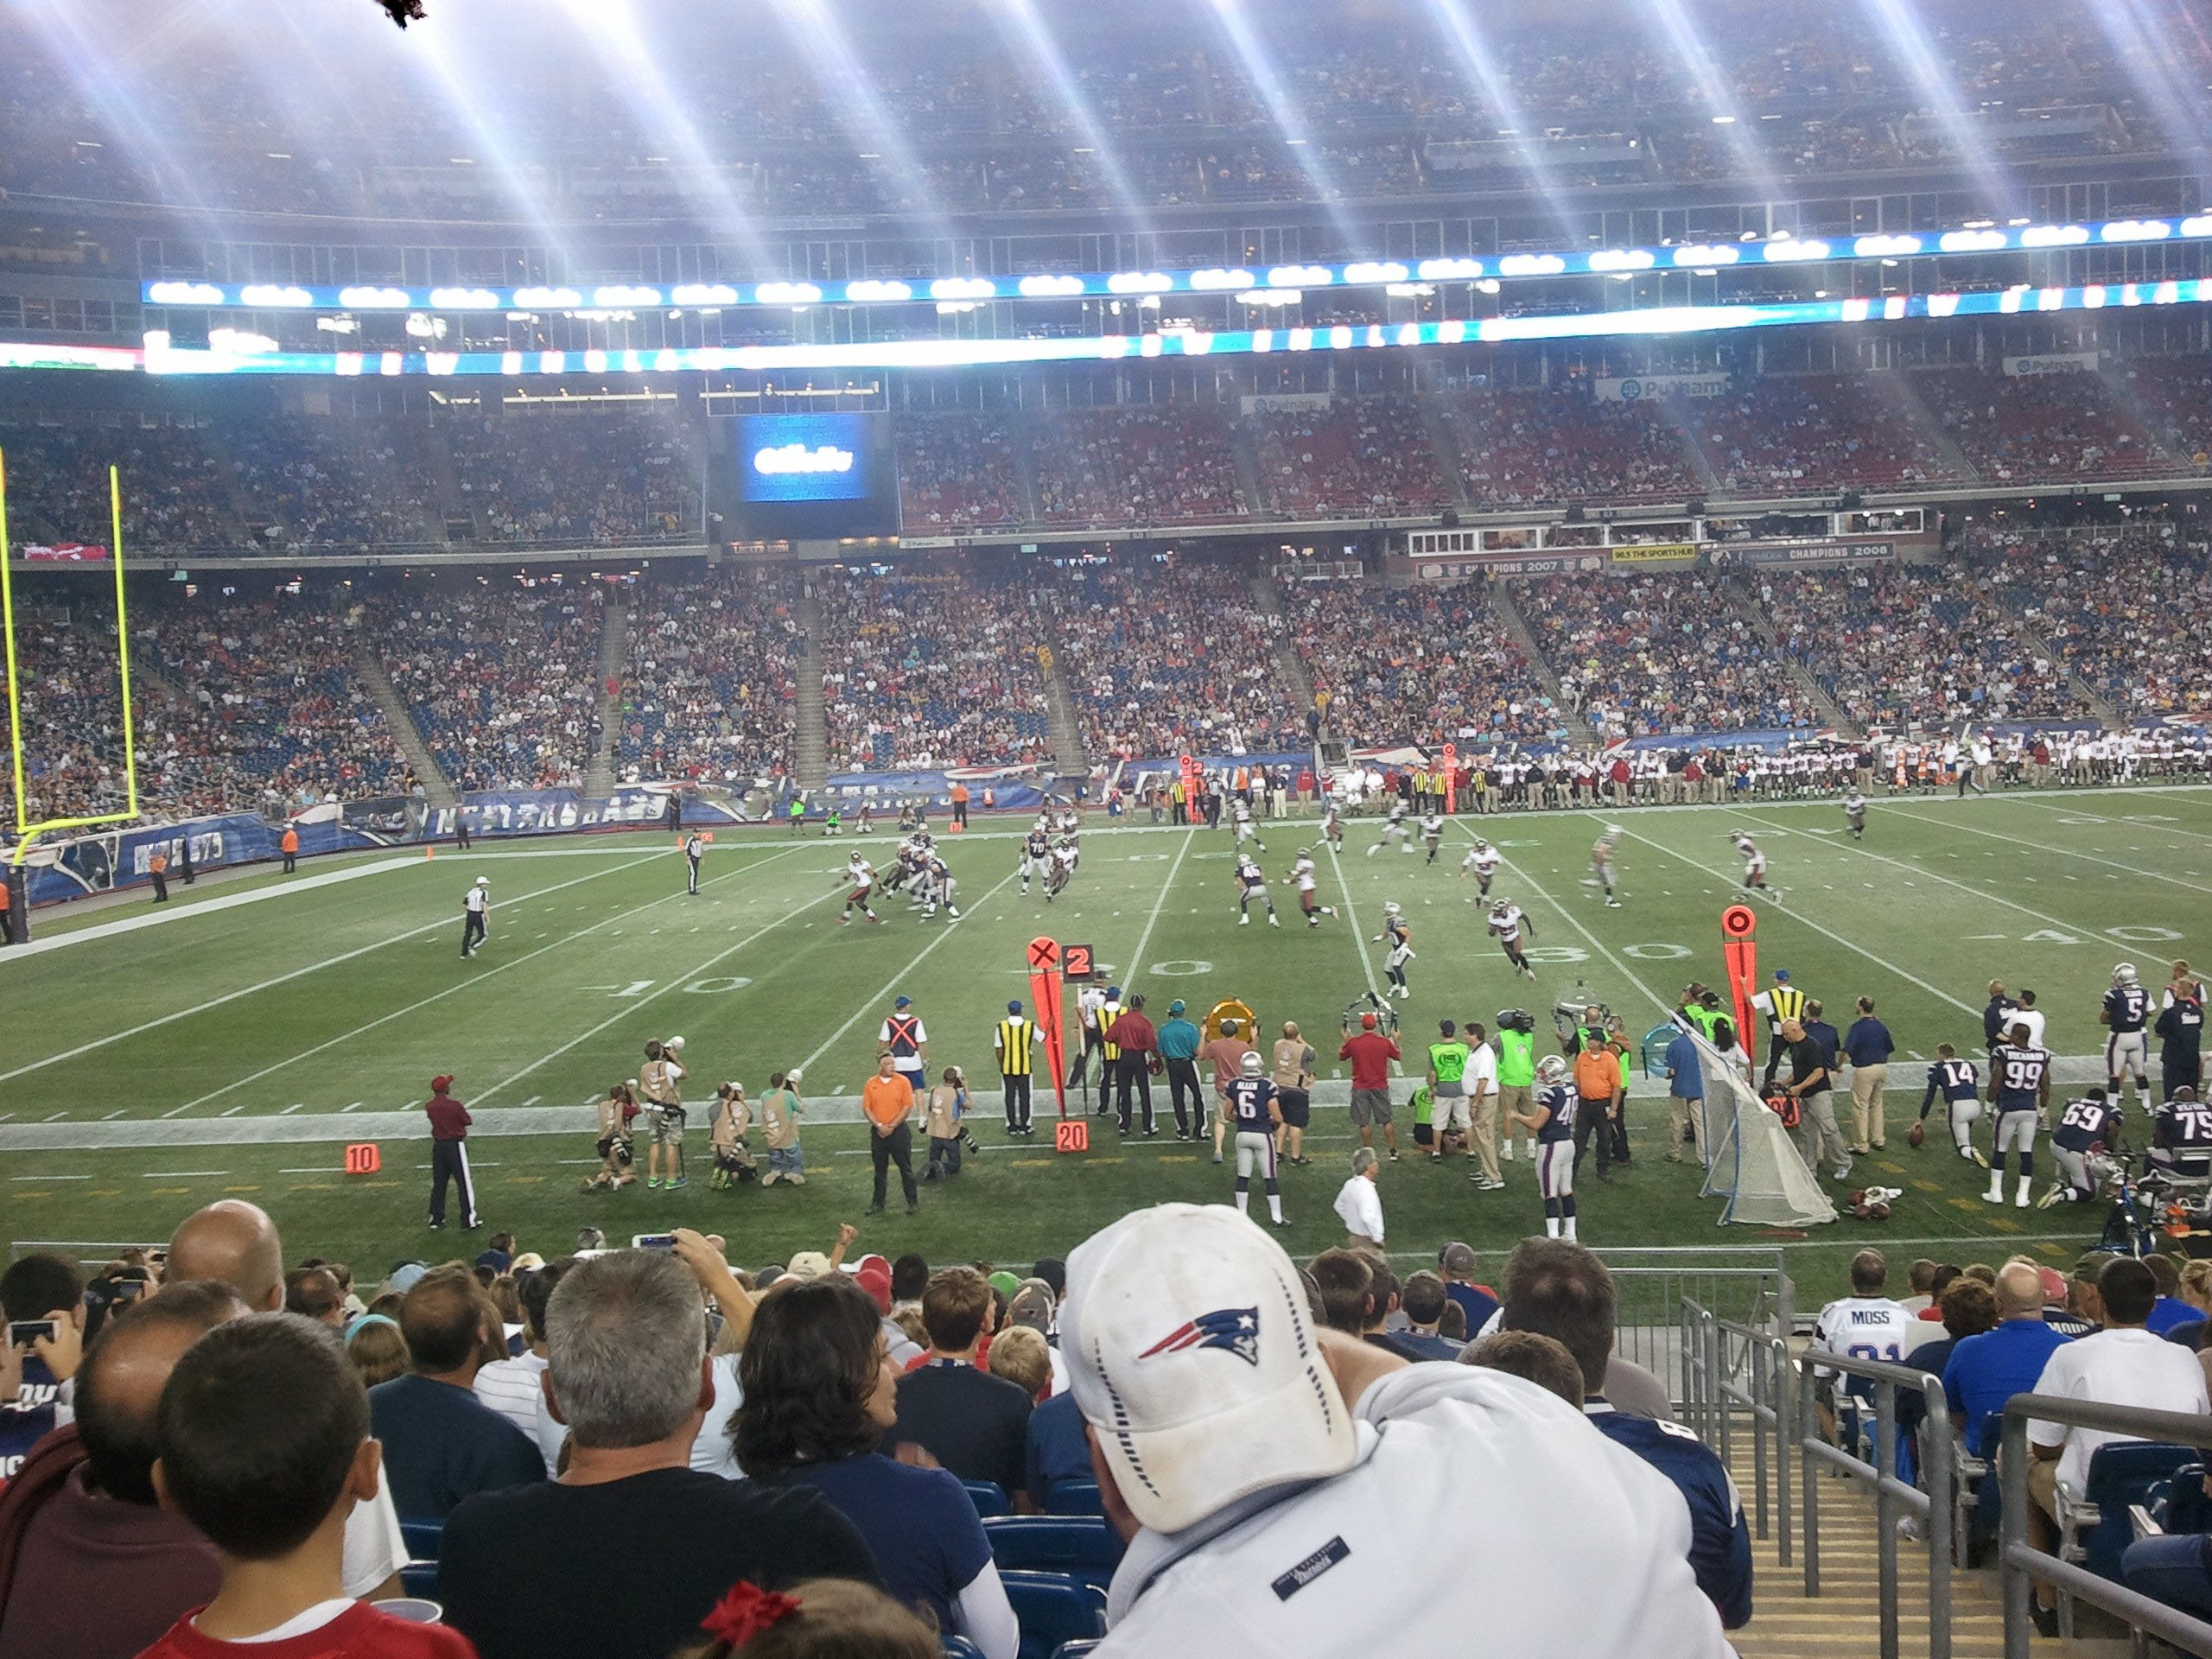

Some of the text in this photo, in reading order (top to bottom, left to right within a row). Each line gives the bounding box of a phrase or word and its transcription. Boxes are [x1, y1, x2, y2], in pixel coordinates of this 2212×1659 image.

[1789, 547, 1848, 560] CHAMPIONS
[1854, 545, 1888, 556] 2008
[1465, 561, 1558, 575] CHPIONS 2007
[1193, 762, 1204, 774] 2
[1031, 842, 1046, 854] 70
[1066, 948, 1090, 975] 2
[2126, 997, 2143, 1022] 5
[1942, 1063, 1975, 1088] 14
[2005, 1062, 2044, 1090] 99
[1238, 1090, 1257, 1119] 6
[2062, 1103, 2105, 1132] 69
[2174, 1111, 2212, 1141] 75
[1059, 1124, 1084, 1149] 20
[349, 1147, 372, 1172] 10
[1851, 1310, 1891, 1325] MOSS
